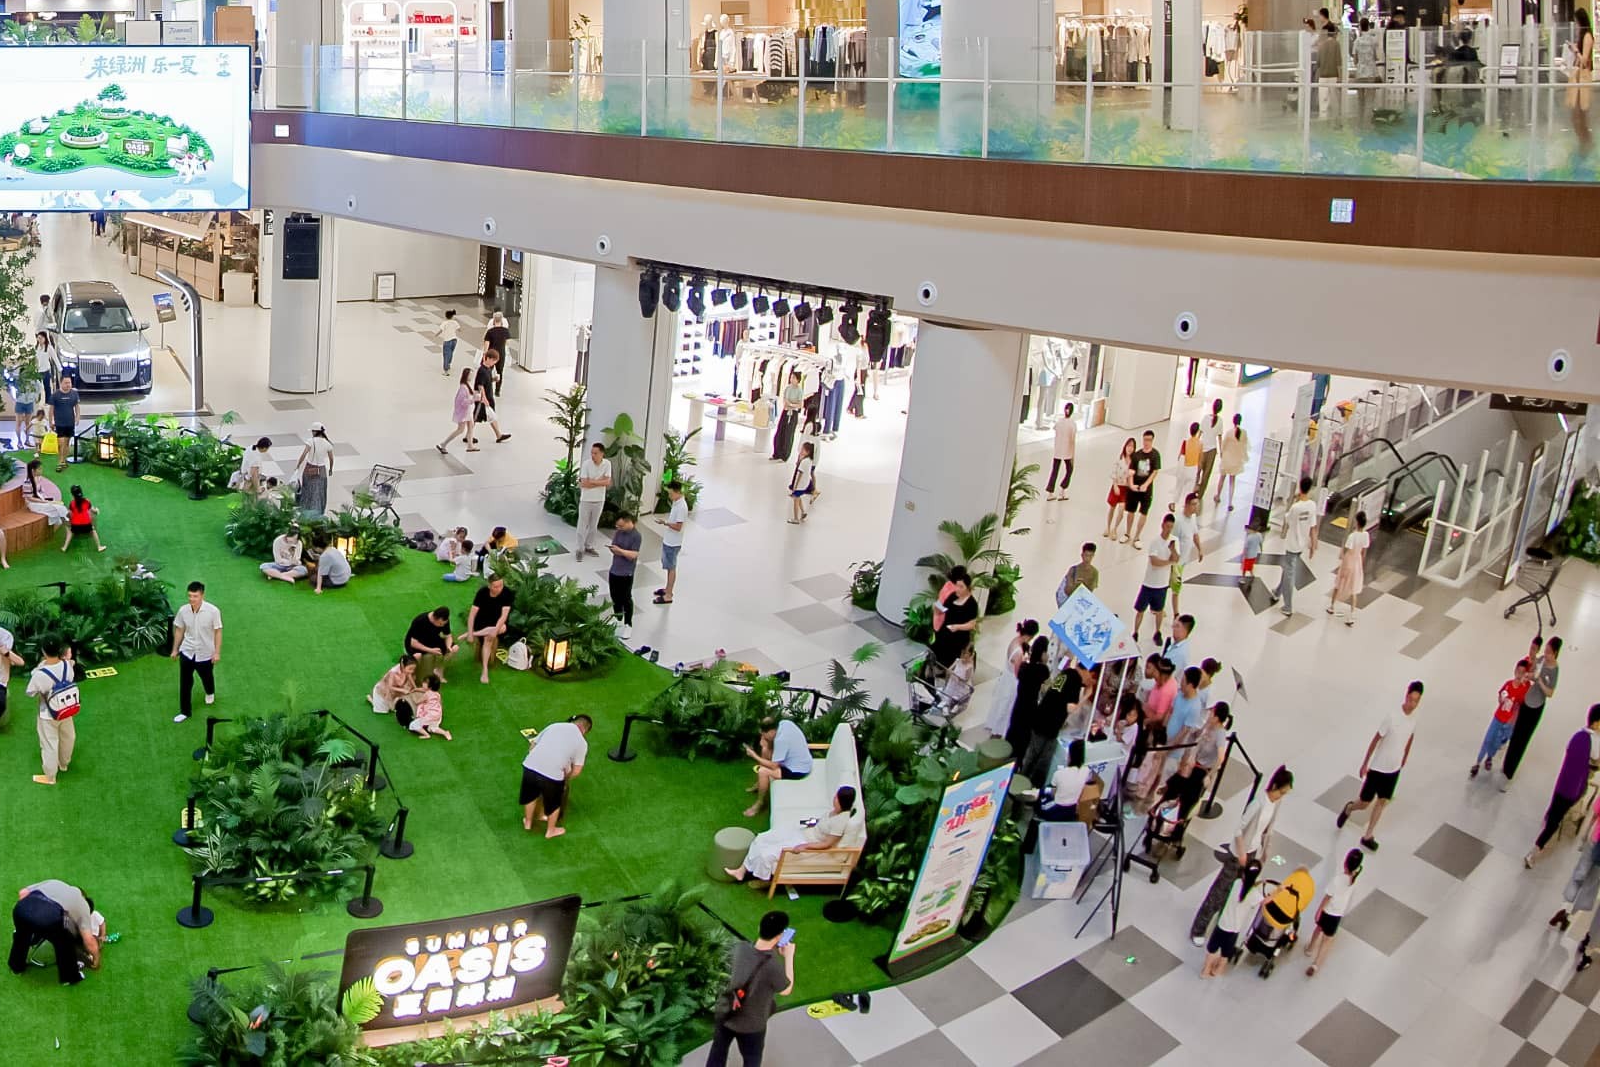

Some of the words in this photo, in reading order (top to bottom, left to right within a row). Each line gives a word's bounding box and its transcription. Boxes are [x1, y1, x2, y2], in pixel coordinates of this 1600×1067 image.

[85, 55, 147, 79] 来绿洲
[151, 55, 199, 75] 乐一夏
[404, 919, 528, 956] SUMMER
[373, 934, 547, 996] OASIS
